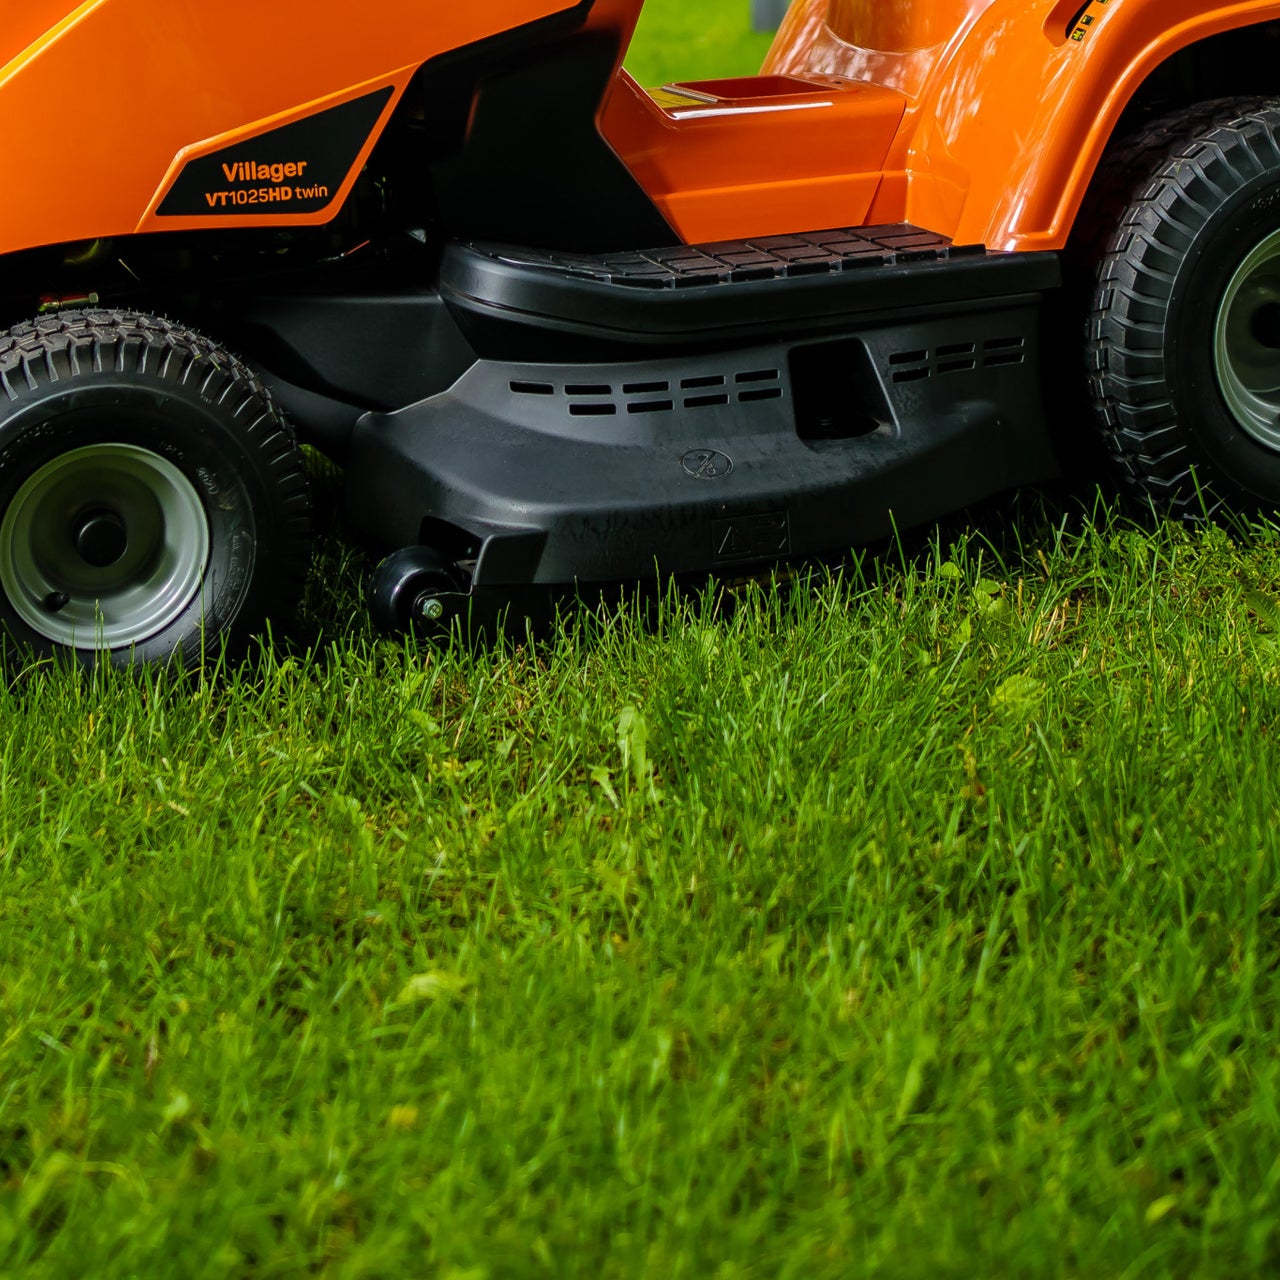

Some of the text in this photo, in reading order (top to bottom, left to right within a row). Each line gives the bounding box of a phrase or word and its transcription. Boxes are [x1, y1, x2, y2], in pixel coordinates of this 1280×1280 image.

[222, 161, 307, 183] Villager
[205, 184, 328, 207] VT1025HD twin
